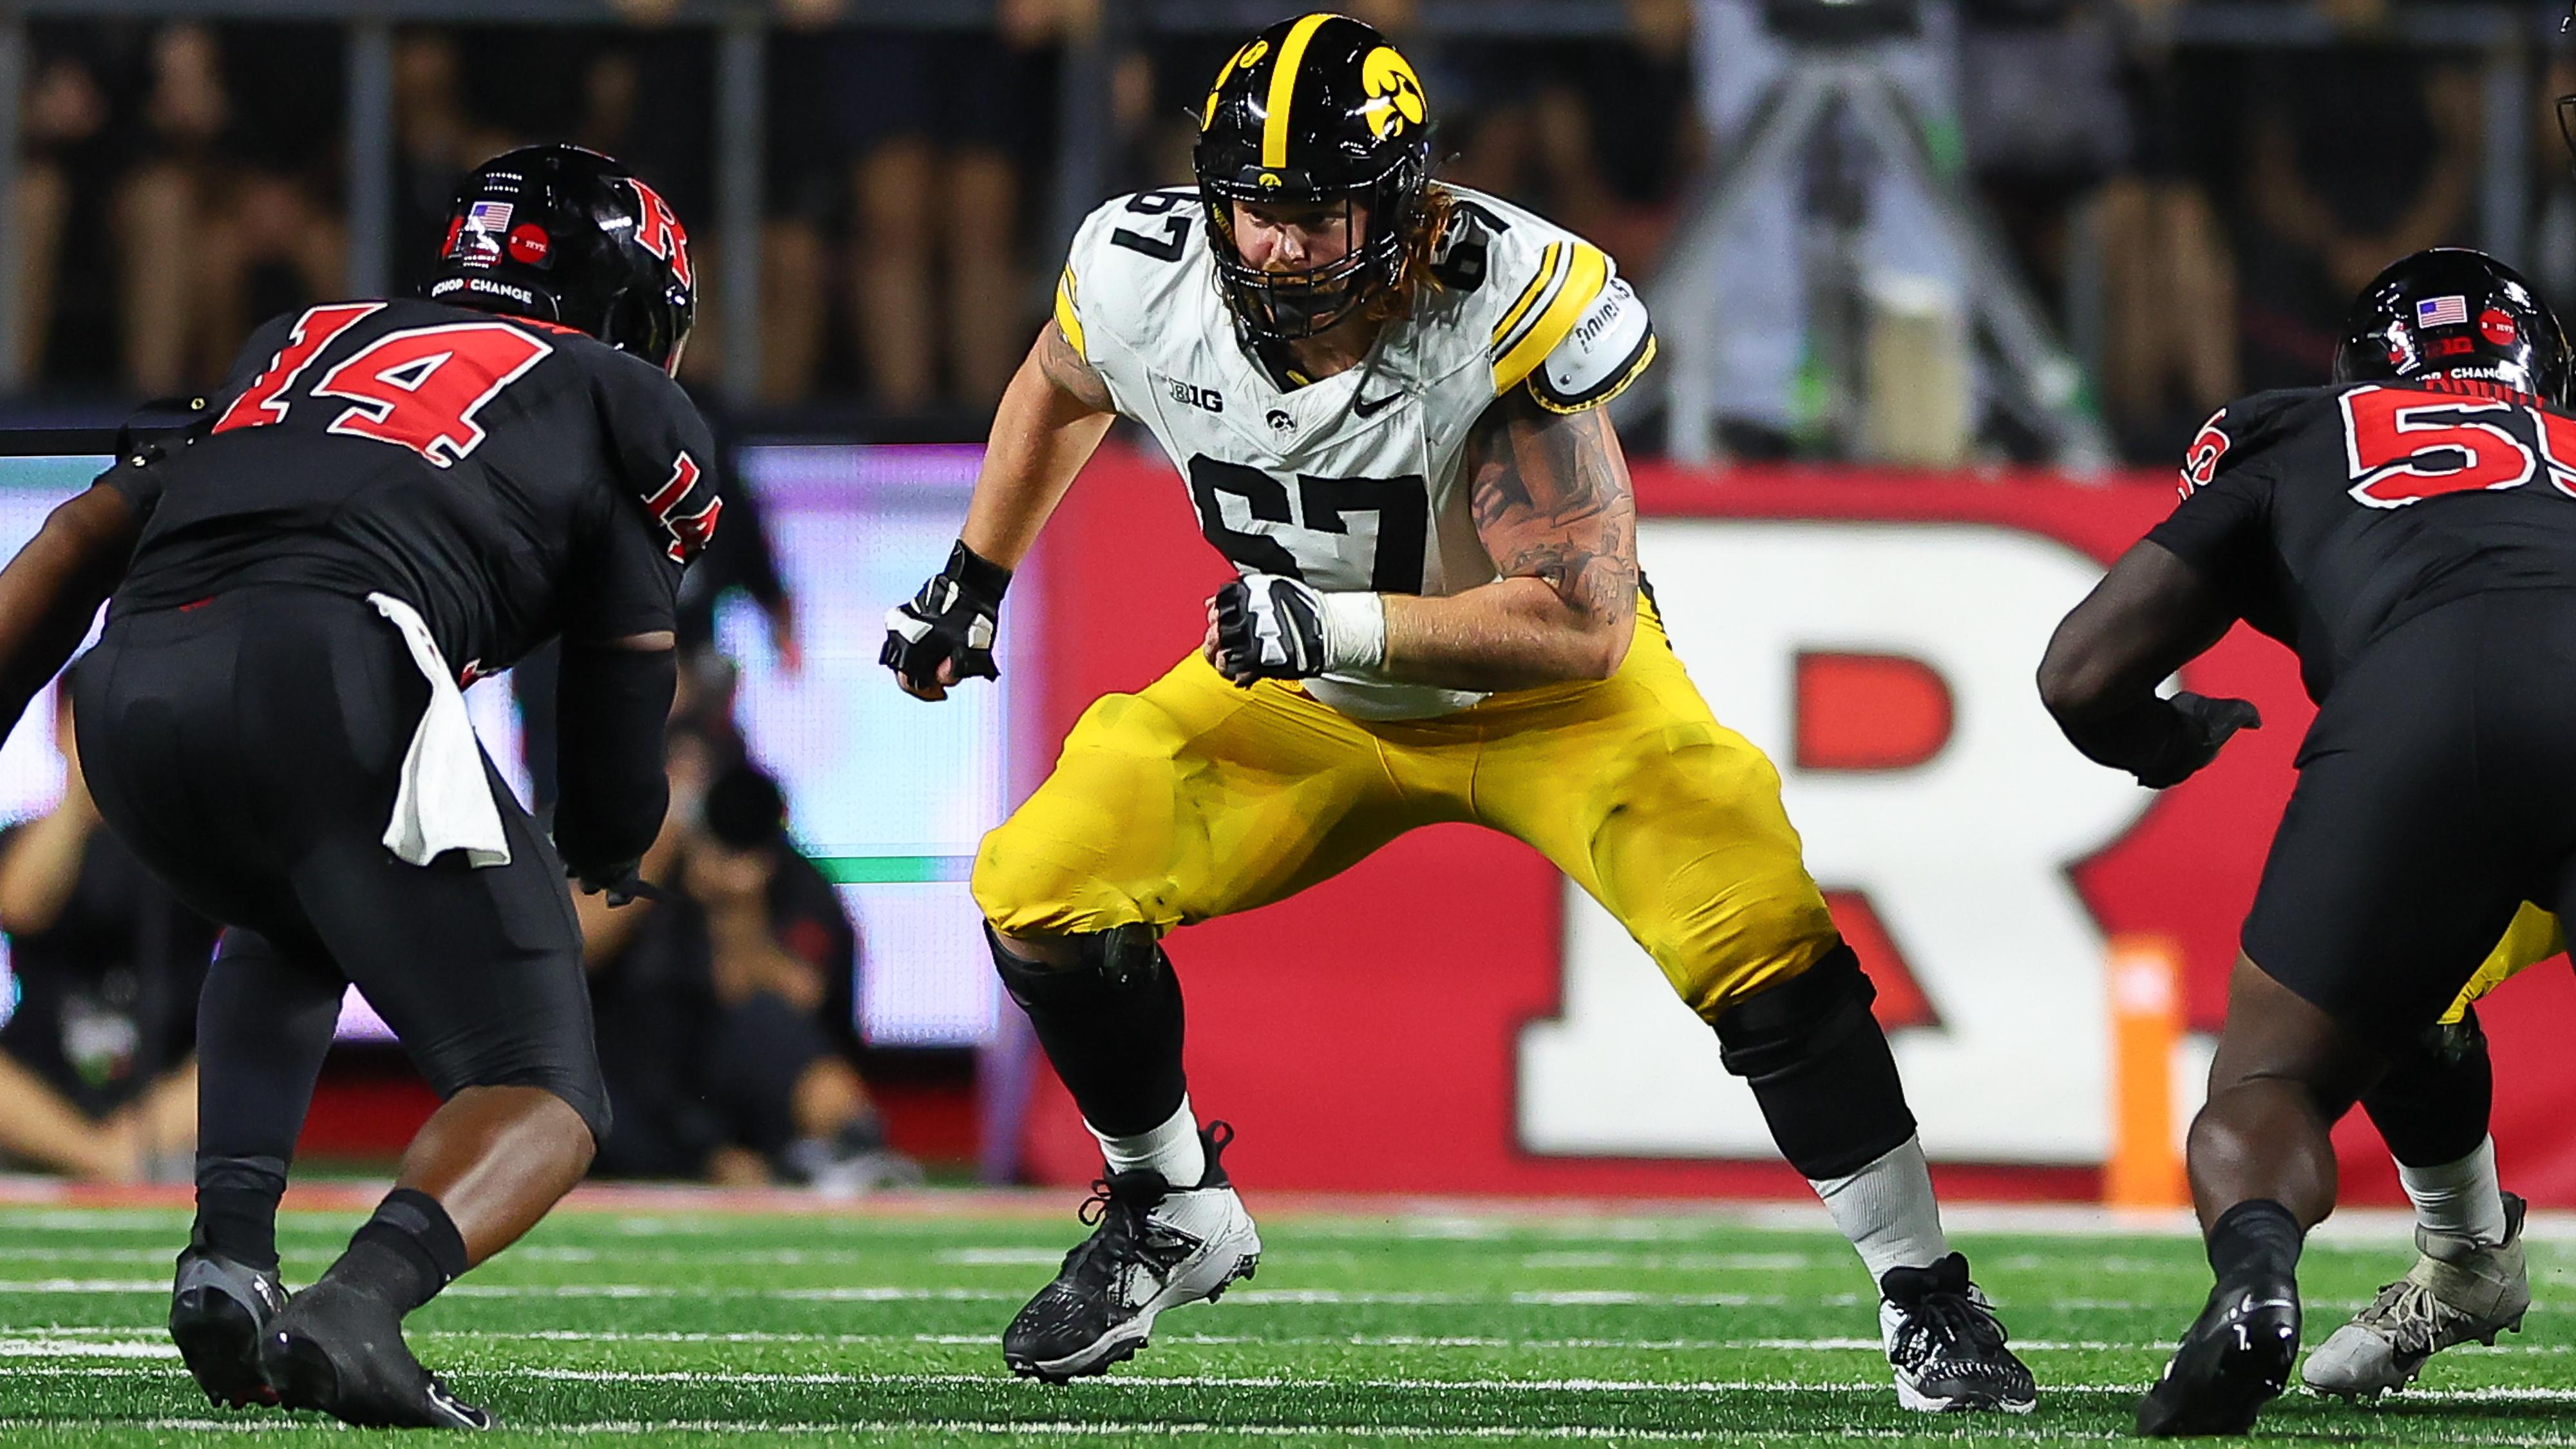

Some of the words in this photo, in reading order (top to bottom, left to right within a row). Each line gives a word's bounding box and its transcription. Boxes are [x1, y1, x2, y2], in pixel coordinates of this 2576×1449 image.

[212, 302, 554, 468] 14
[641, 450, 723, 565] 14
[1188, 452, 1427, 596] 67
[1515, 520, 2219, 1160] R
